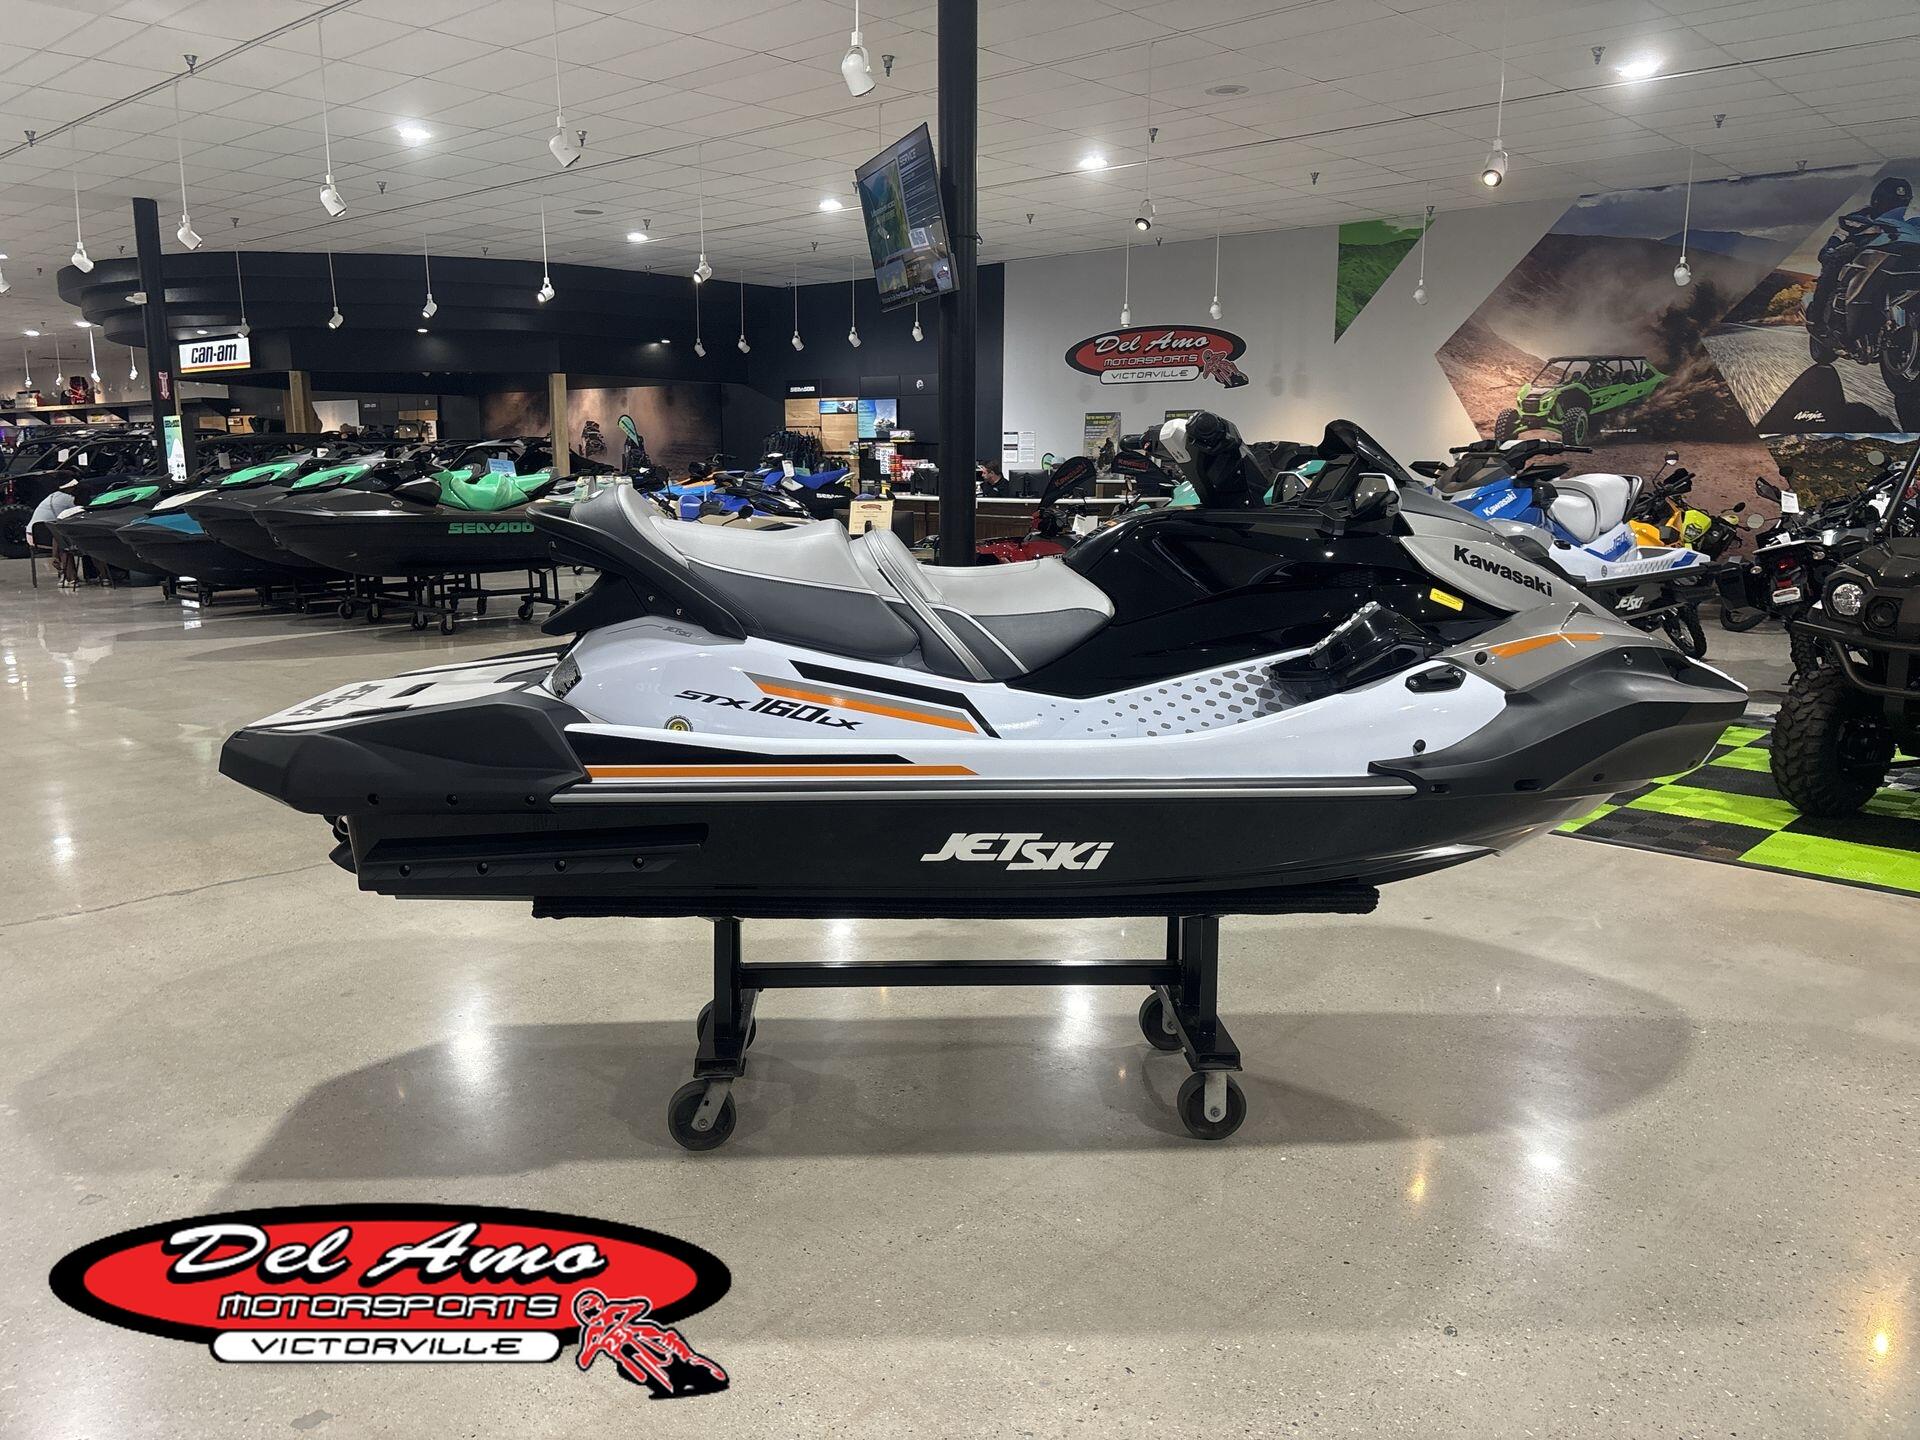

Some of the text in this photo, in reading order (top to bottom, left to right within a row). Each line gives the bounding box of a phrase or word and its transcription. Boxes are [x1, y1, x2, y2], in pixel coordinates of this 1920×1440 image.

[1095, 330, 1209, 353] Del Amo
[1103, 354, 1199, 367] MOTORSPORTS
[1111, 369, 1190, 379] VICTORVILLE
[1482, 489, 1518, 516] Kawasaki
[1453, 544, 1553, 598] Kawasaki
